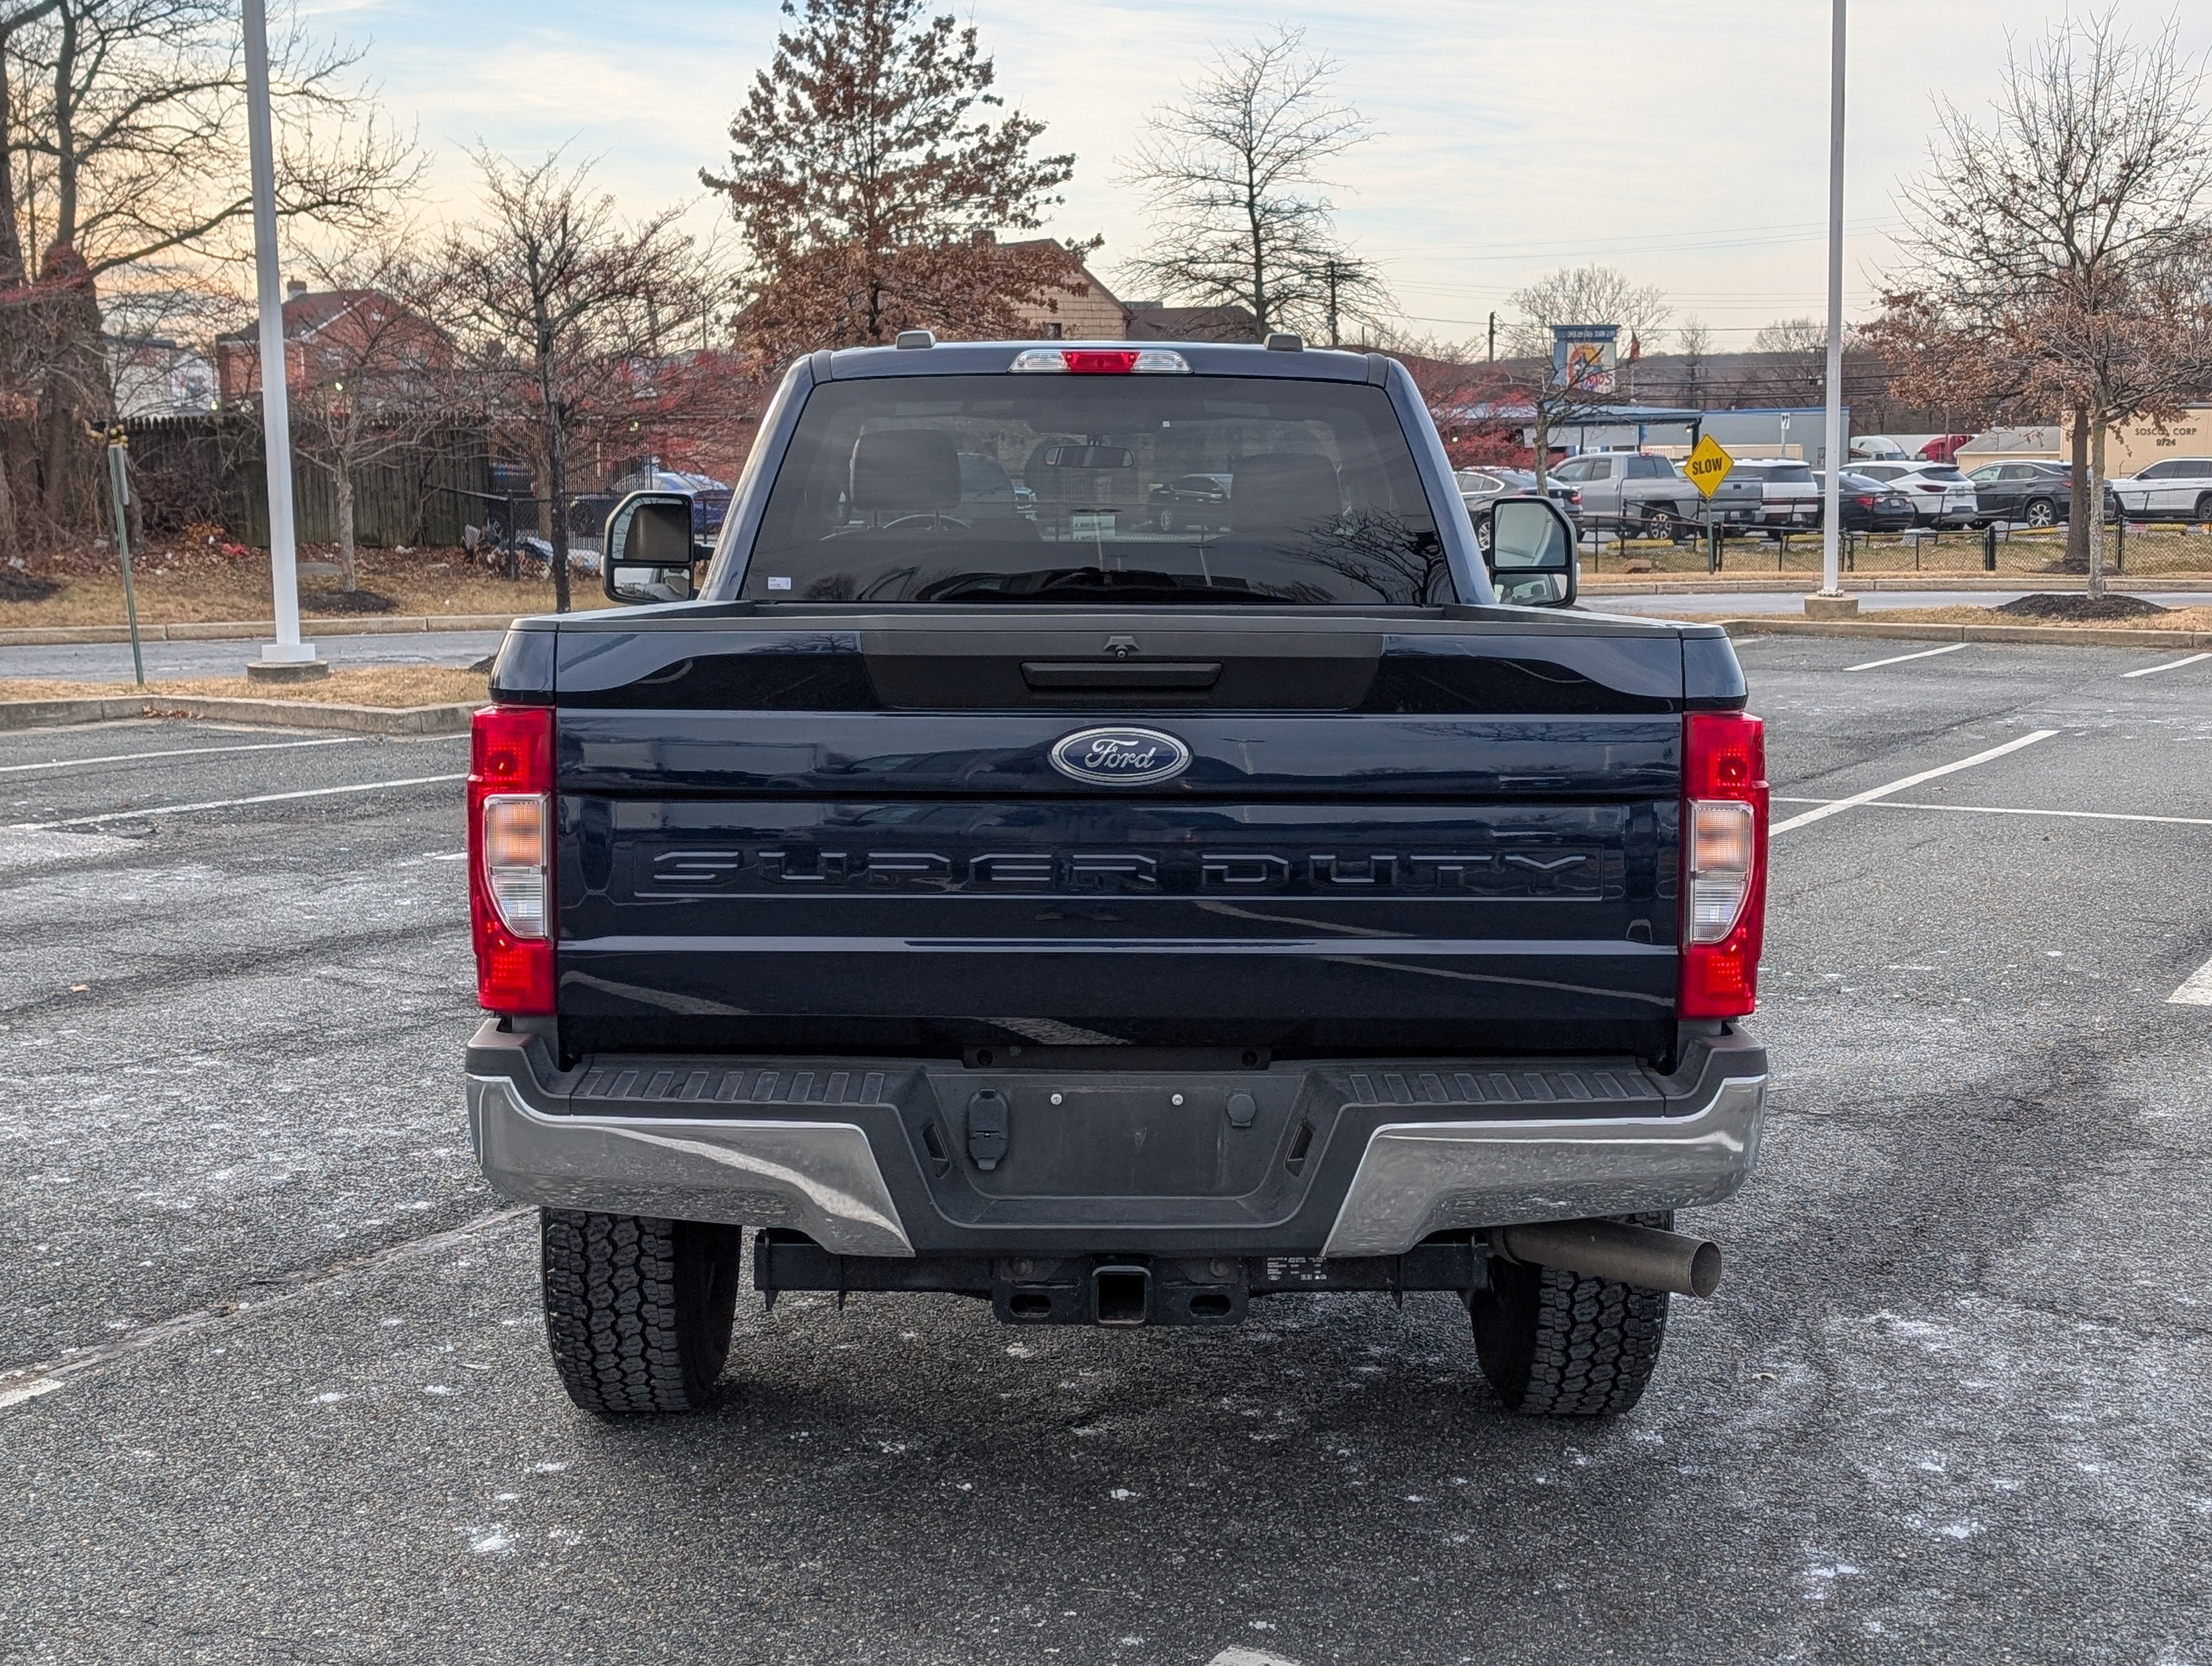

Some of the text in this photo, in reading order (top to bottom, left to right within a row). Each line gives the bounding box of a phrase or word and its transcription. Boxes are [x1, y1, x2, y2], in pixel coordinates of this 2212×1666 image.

[1692, 457, 1722, 476] SLOW
[1085, 739, 1158, 768] Ford
[652, 850, 1587, 893] SUPER DUTY
